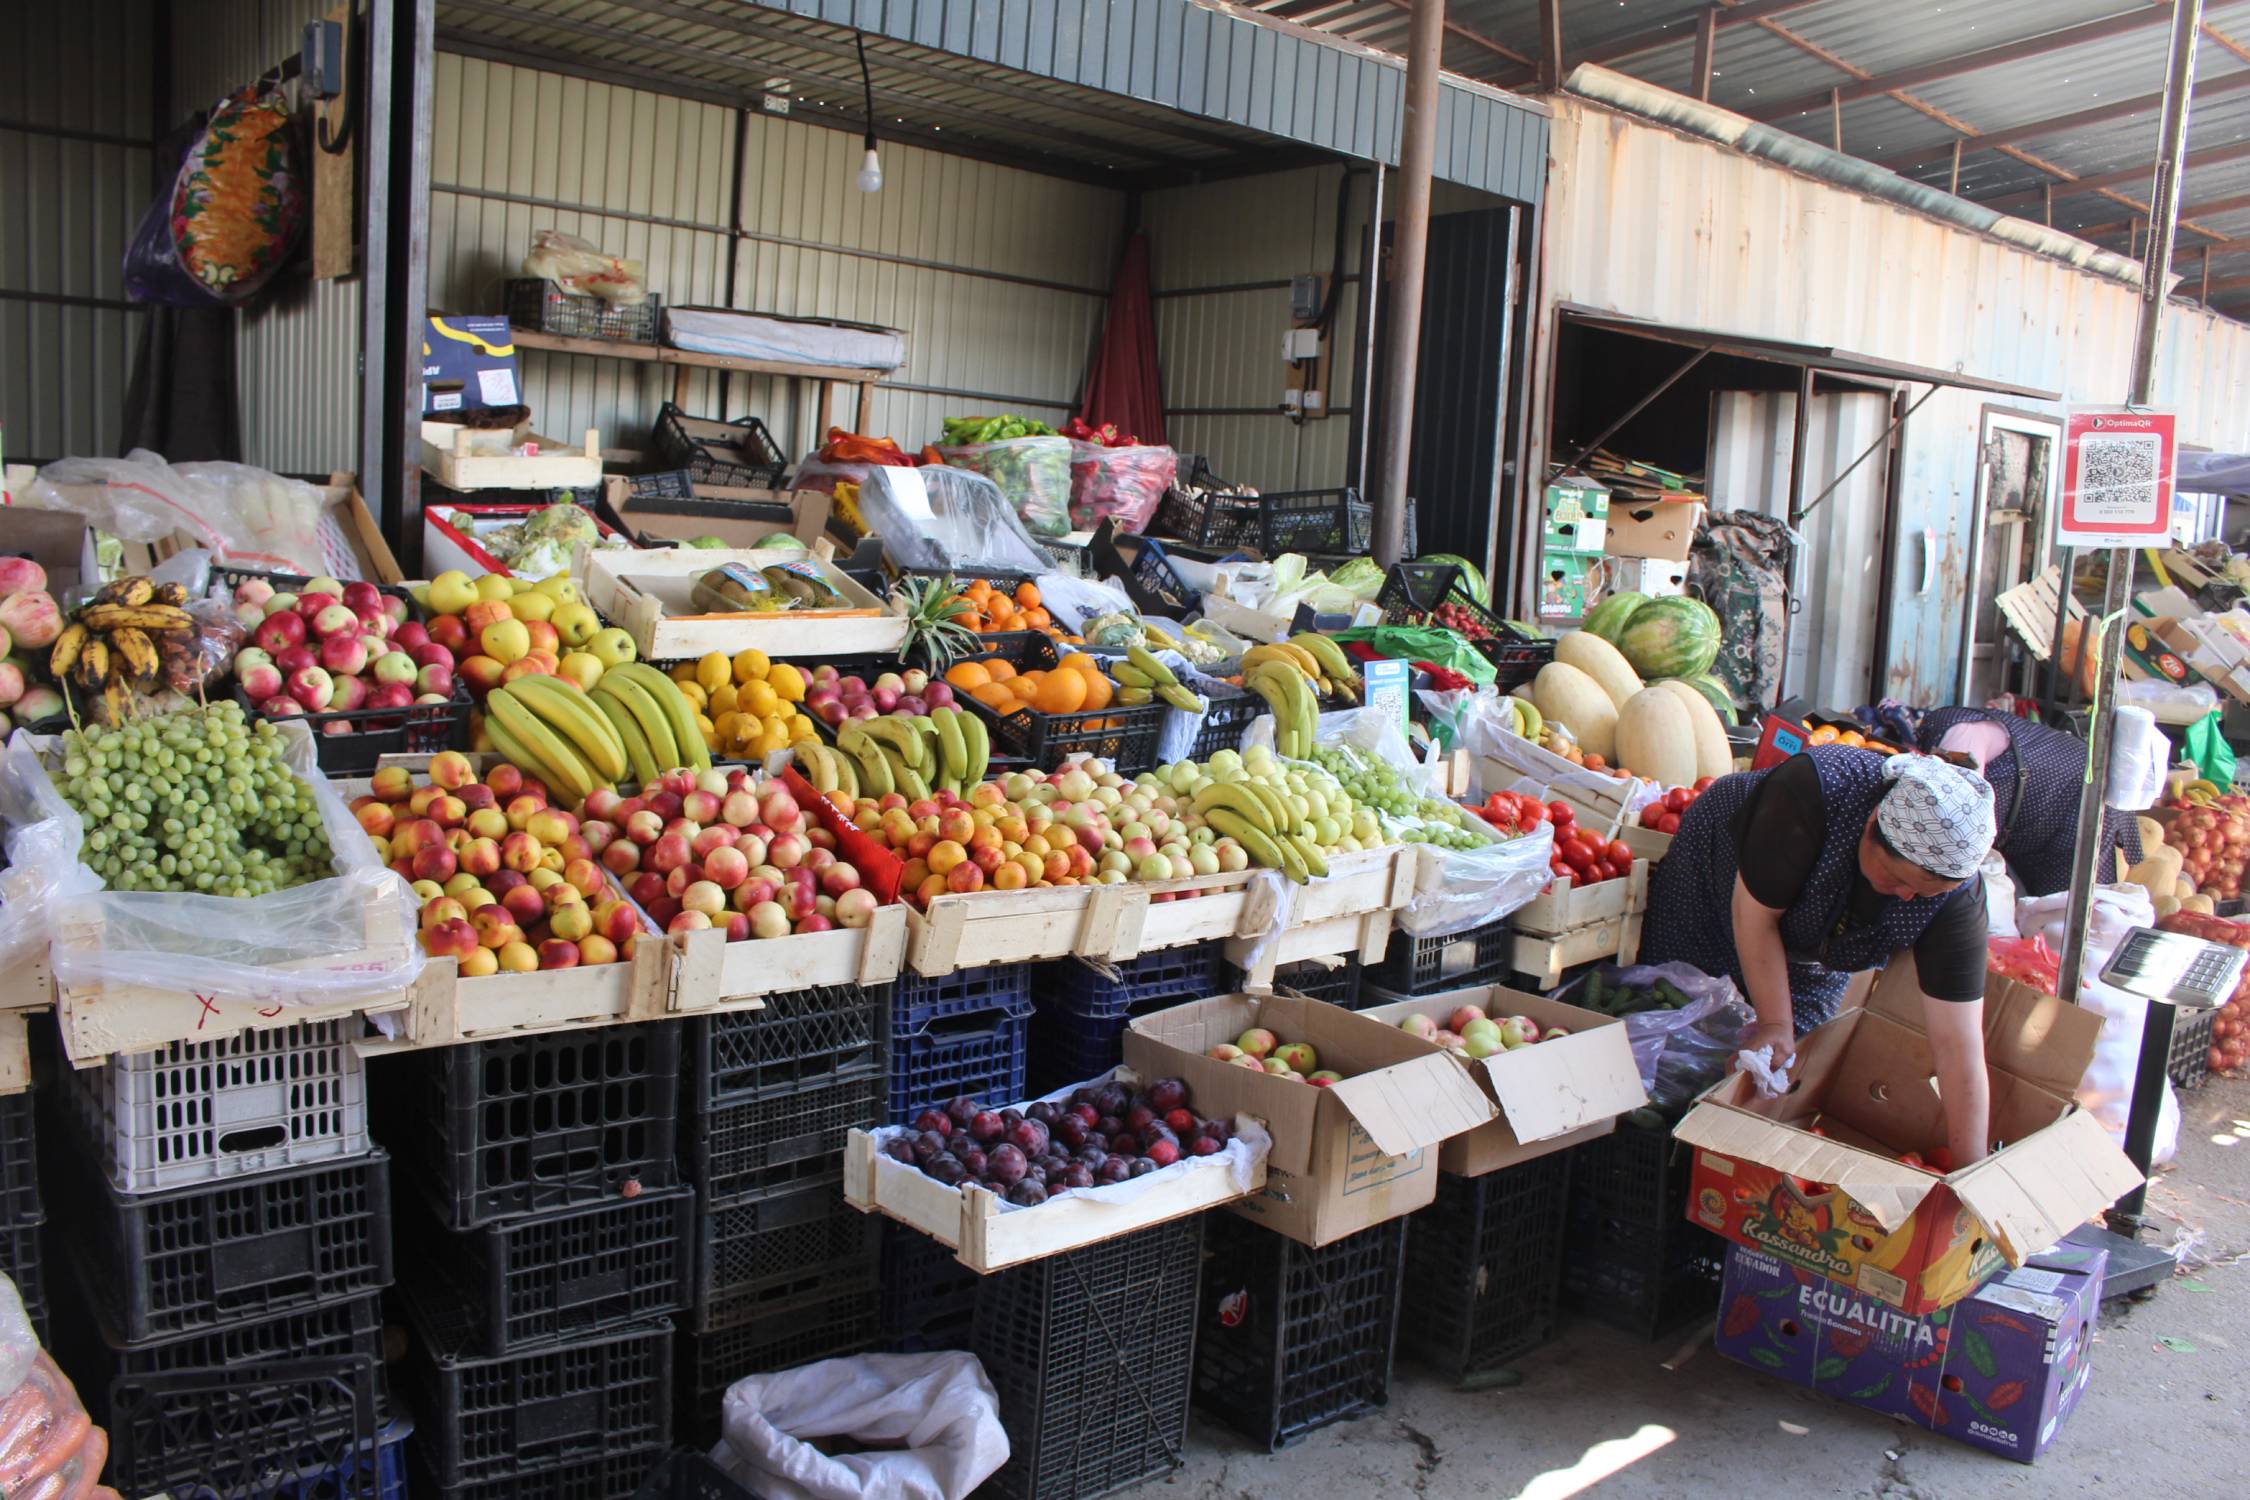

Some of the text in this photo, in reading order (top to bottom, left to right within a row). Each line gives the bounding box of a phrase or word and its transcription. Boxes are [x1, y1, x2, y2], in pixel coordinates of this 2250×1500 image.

[2107, 419, 2152, 428] OptimaQR
[1741, 1217, 1853, 1275] Kassandra
[1798, 1284, 1934, 1347] ECUALITTA
